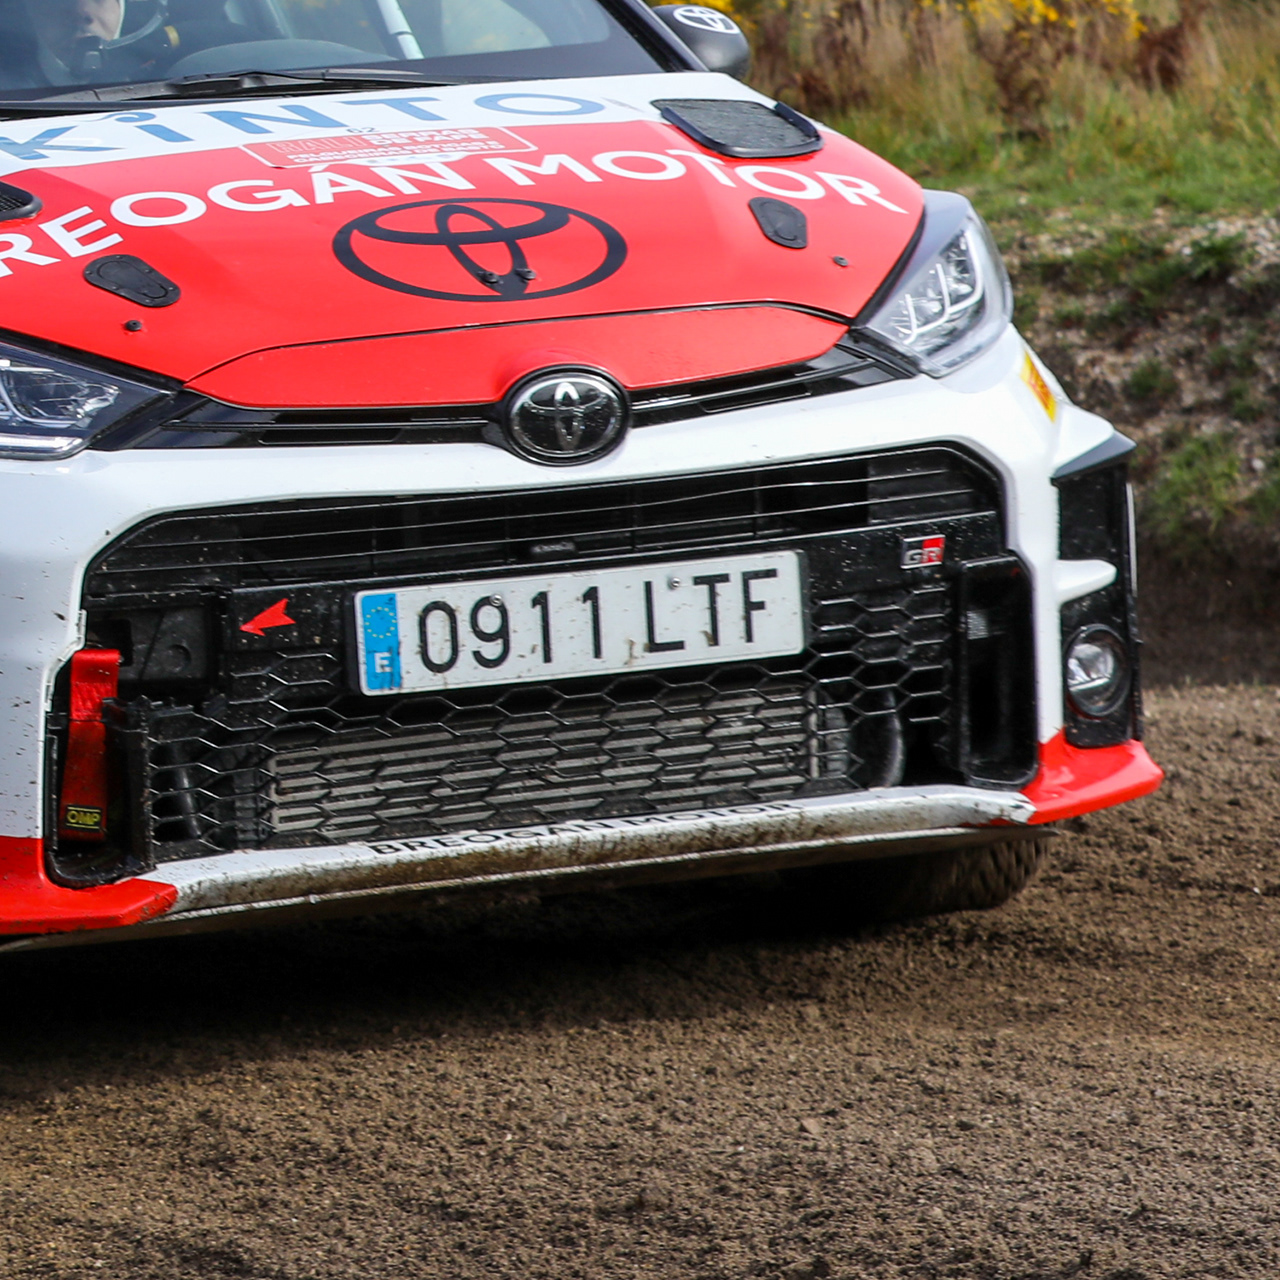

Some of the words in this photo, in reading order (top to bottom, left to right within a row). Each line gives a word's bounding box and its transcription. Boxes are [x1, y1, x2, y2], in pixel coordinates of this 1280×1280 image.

[484, 149, 909, 214] MOTOR
[903, 547, 942, 565] GR
[418, 585, 602, 673] 0911
[644, 568, 778, 653] LTF
[67, 810, 101, 825] OMP
